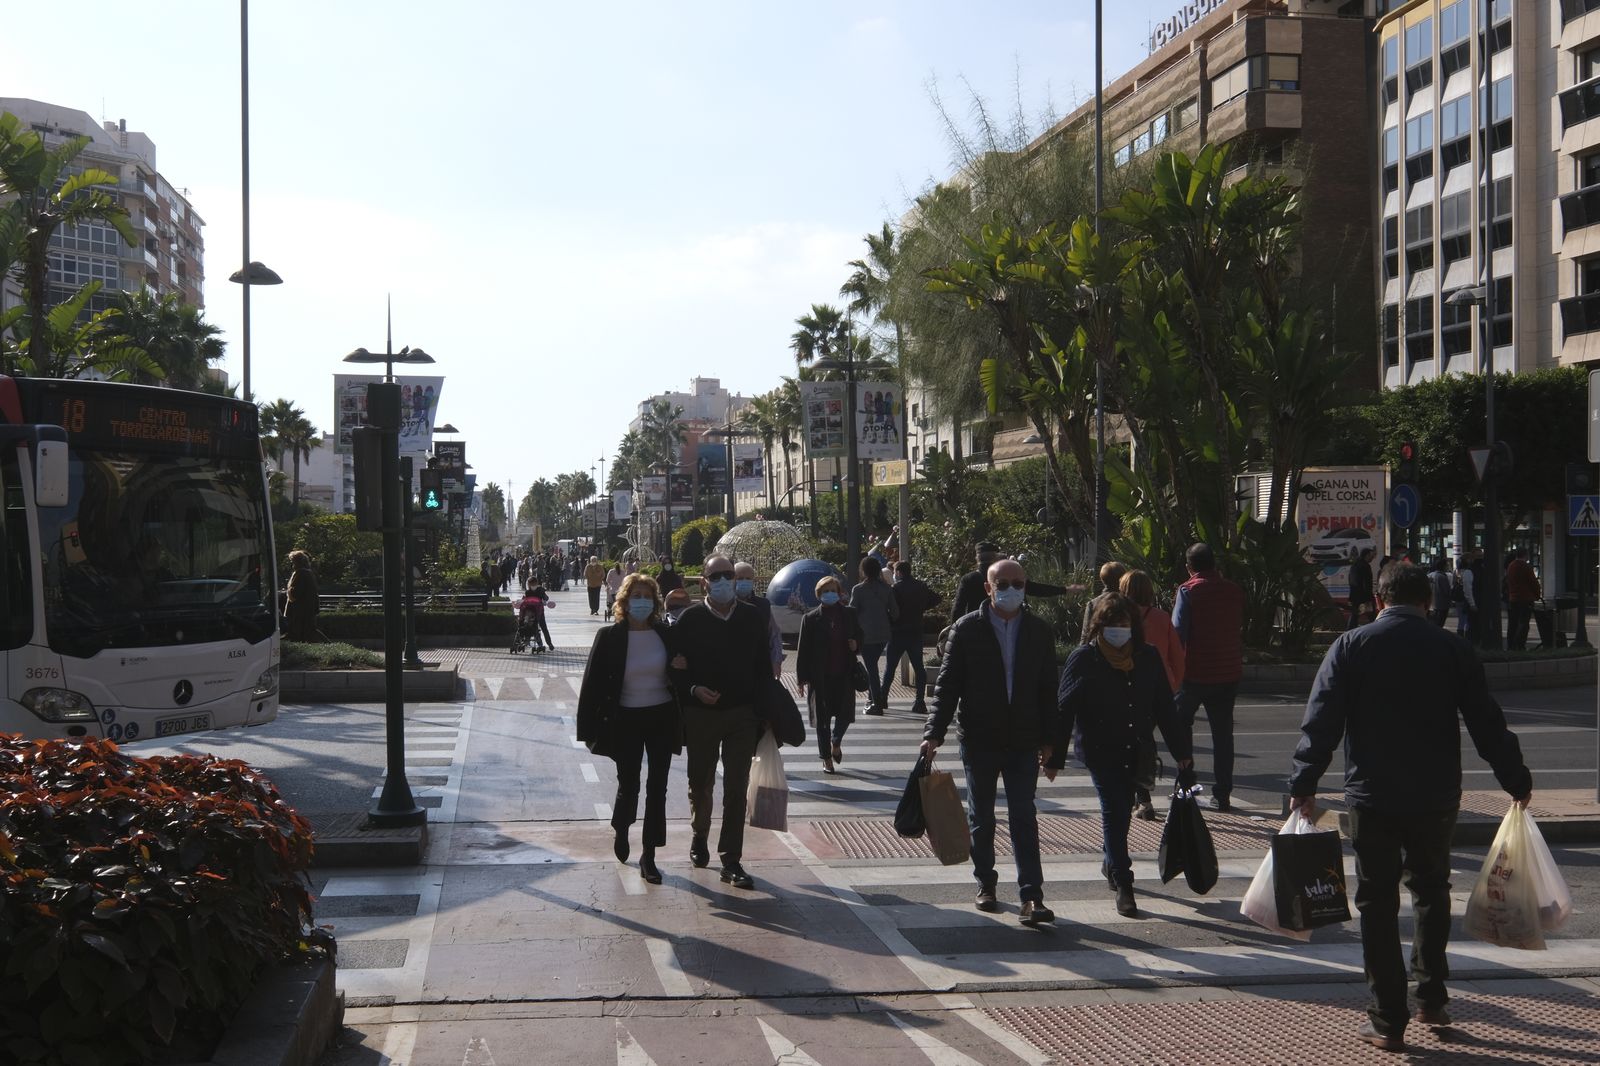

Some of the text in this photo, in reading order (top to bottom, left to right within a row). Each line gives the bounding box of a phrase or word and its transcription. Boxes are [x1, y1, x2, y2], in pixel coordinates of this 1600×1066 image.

[63, 398, 88, 433] 18
[139, 406, 189, 427] CENTRO
[110, 417, 210, 446] TORRECARDENAS
[1352, 479, 1369, 489] UN
[1305, 490, 1377, 501] OPEL CORSA!
[227, 650, 247, 660] ALSA
[25, 667, 59, 680] 3676
[162, 716, 209, 734] 2700 JES
